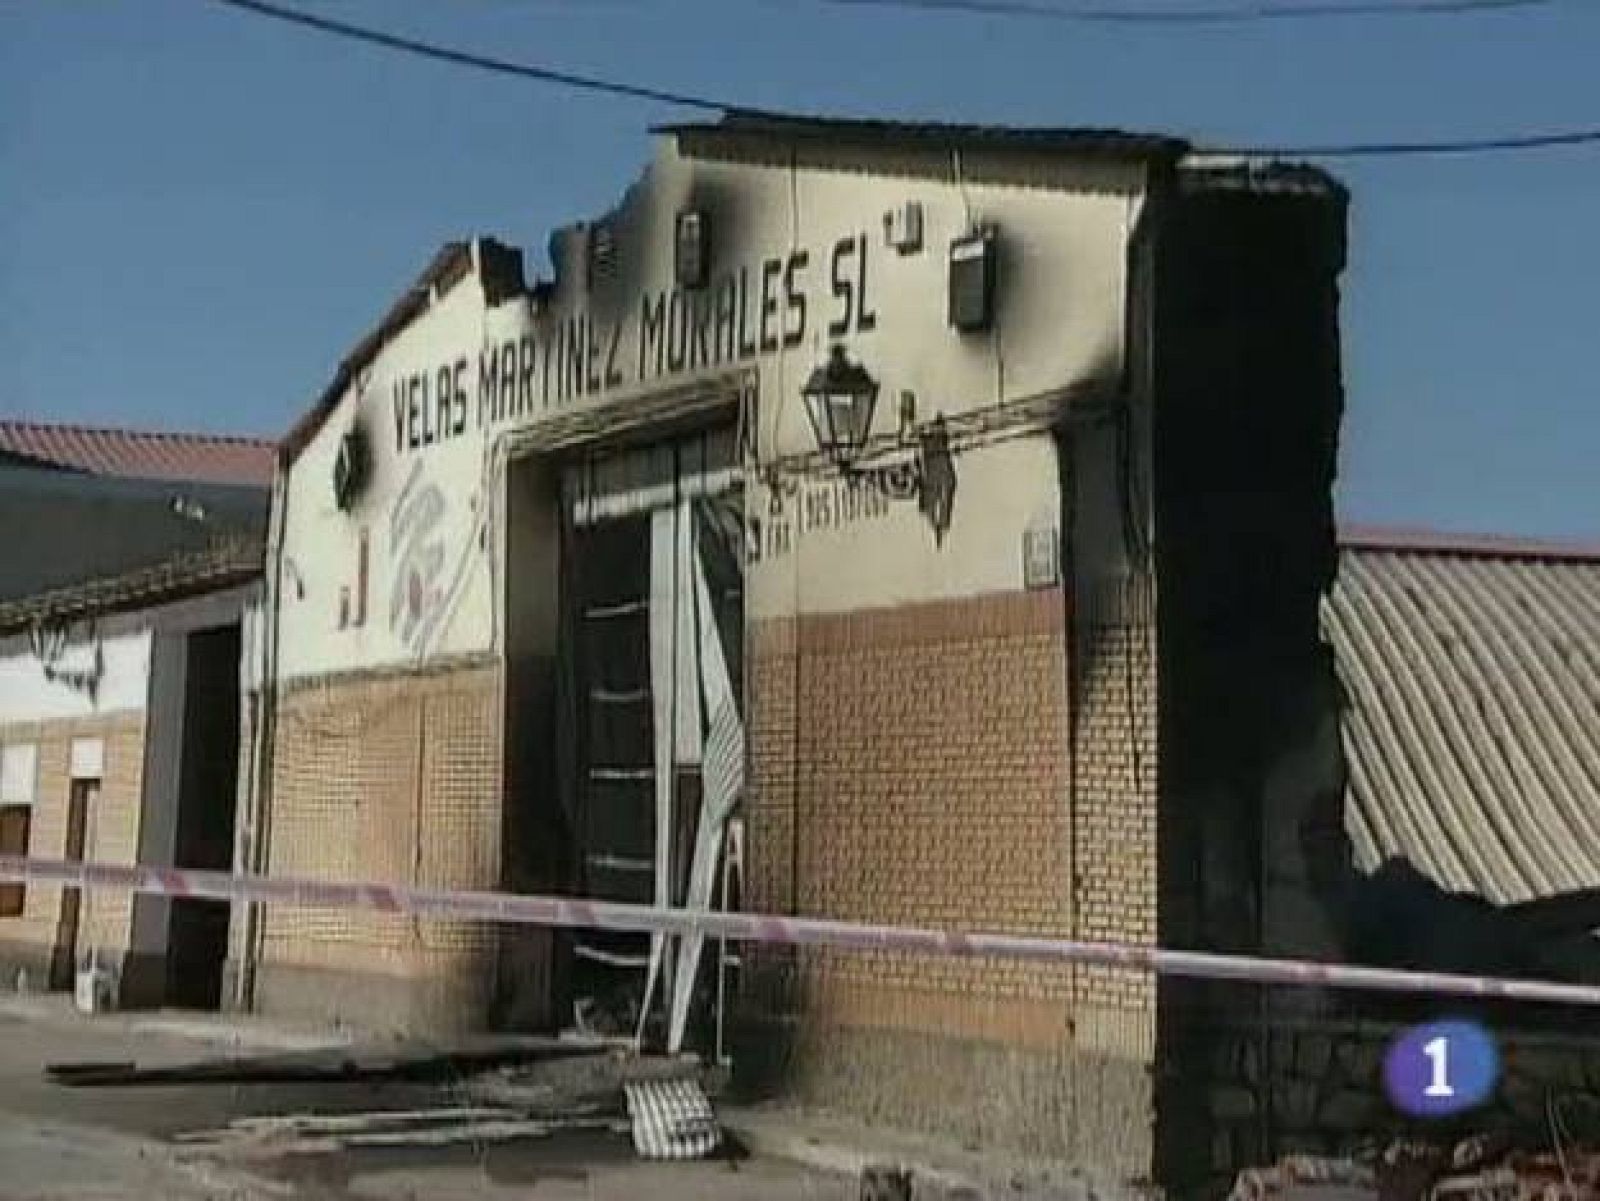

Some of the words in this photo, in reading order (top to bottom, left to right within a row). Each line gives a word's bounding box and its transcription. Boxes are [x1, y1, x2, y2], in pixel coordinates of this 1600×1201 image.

[393, 357, 467, 452] VELAS
[478, 312, 623, 430] MARTINEZ
[640, 249, 808, 382] MORALES
